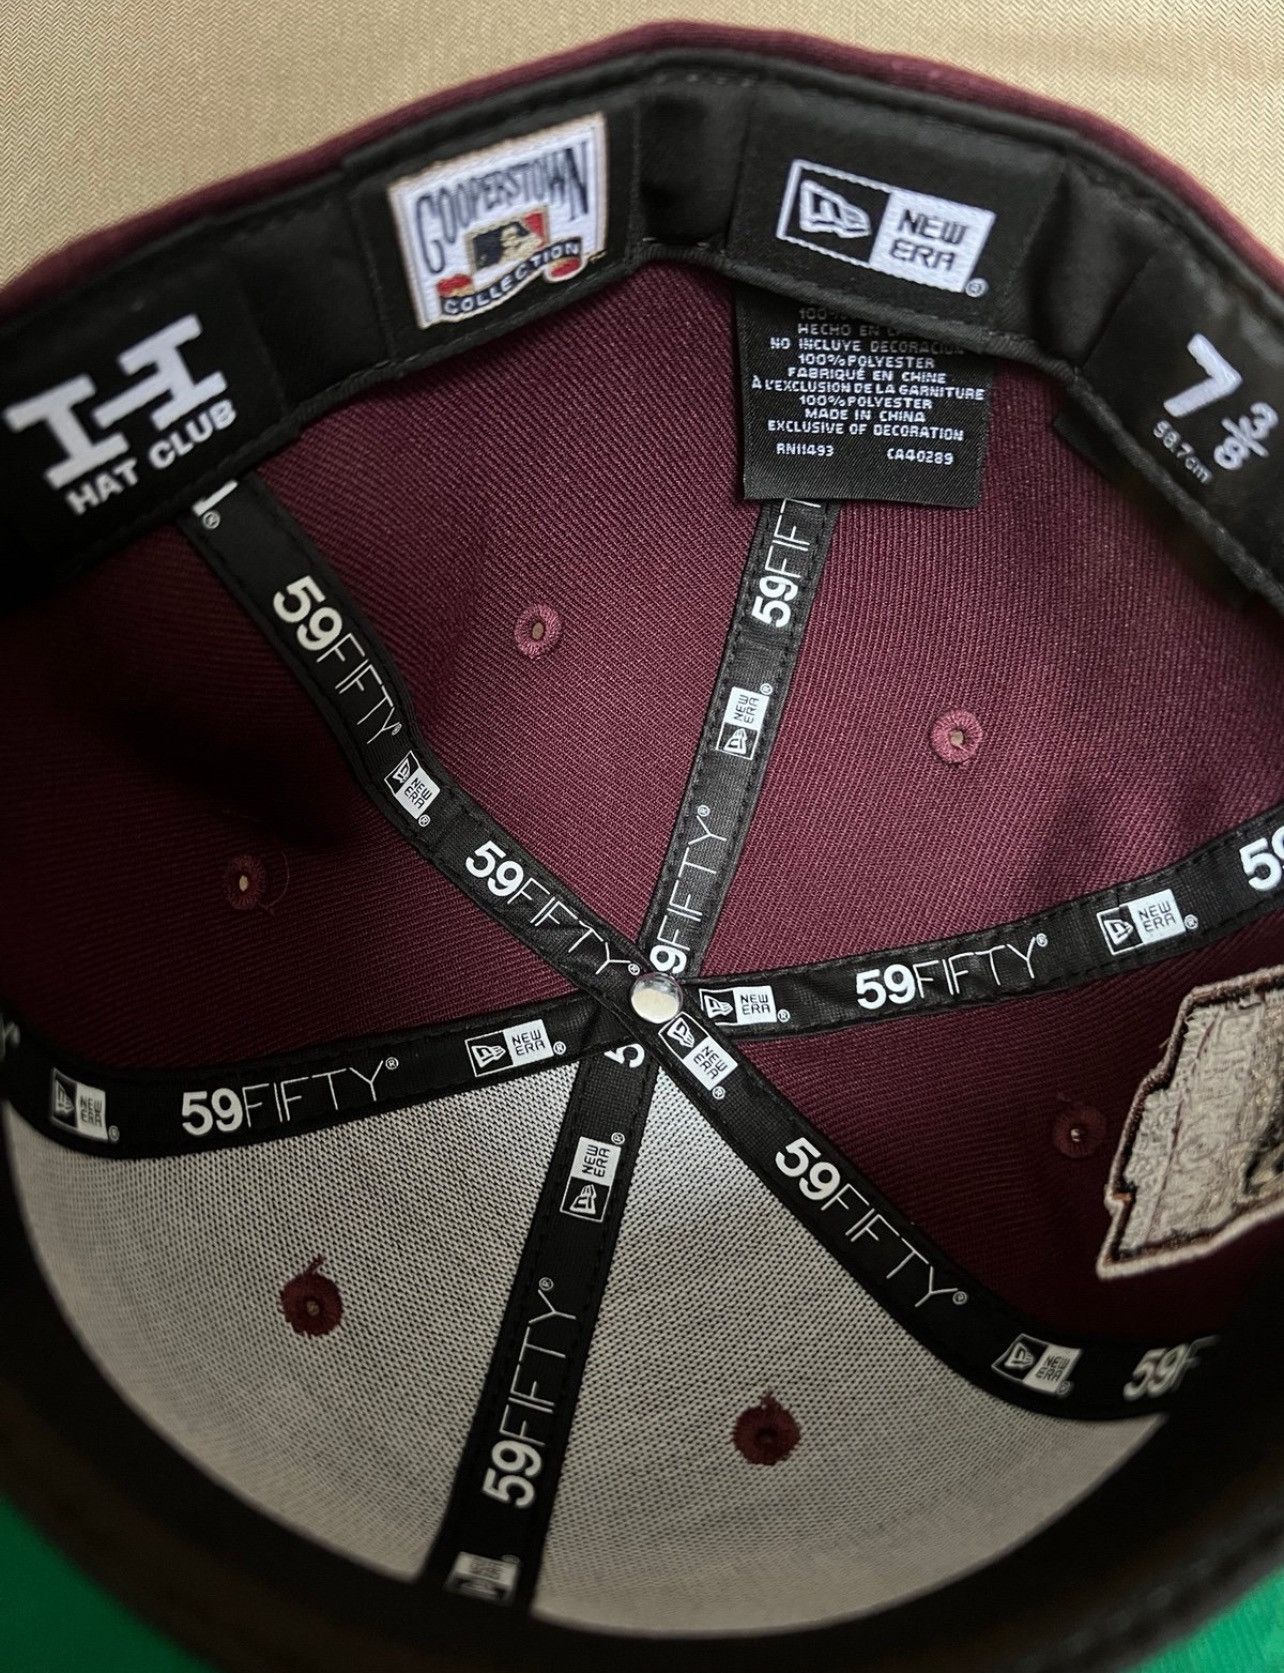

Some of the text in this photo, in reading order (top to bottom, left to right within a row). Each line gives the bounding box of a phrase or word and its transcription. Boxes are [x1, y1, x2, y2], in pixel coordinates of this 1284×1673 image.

[898, 208, 969, 246] NEW
[889, 238, 956, 271] ERA
[443, 237, 581, 315] COLLECTION
[798, 323, 852, 336] HECHO
[770, 337, 791, 350] NO
[798, 338, 861, 352] INCLUYE
[787, 366, 947, 385] FABRIQUÉ EN CHINE
[1163, 332, 1243, 418] 7
[854, 382, 873, 394] DE
[875, 383, 896, 395] LA
[899, 384, 985, 401] GARNITURE
[804, 408, 926, 423] MADE IN CHINA
[767, 420, 964, 441] EXCLUSIVE OF DECORATION
[65, 399, 237, 516] HAT CLUB
[776, 443, 954, 466] RN11493 CA40289
[733, 694, 749, 721] NEW
[743, 697, 760, 725] ERA
[403, 787, 426, 810] ERA
[411, 777, 432, 800] NEW
[1137, 900, 1172, 921] NEW
[1143, 914, 1177, 933] ERA
[740, 993, 769, 1004] NEW
[740, 1003, 771, 1015] ERA
[511, 1029, 542, 1047] NEW
[515, 1040, 545, 1056] ERA
[693, 1054, 720, 1080] ERA
[702, 1045, 728, 1072] NEW
[581, 1144, 599, 1175] NEW
[593, 1149, 610, 1178] ERA
